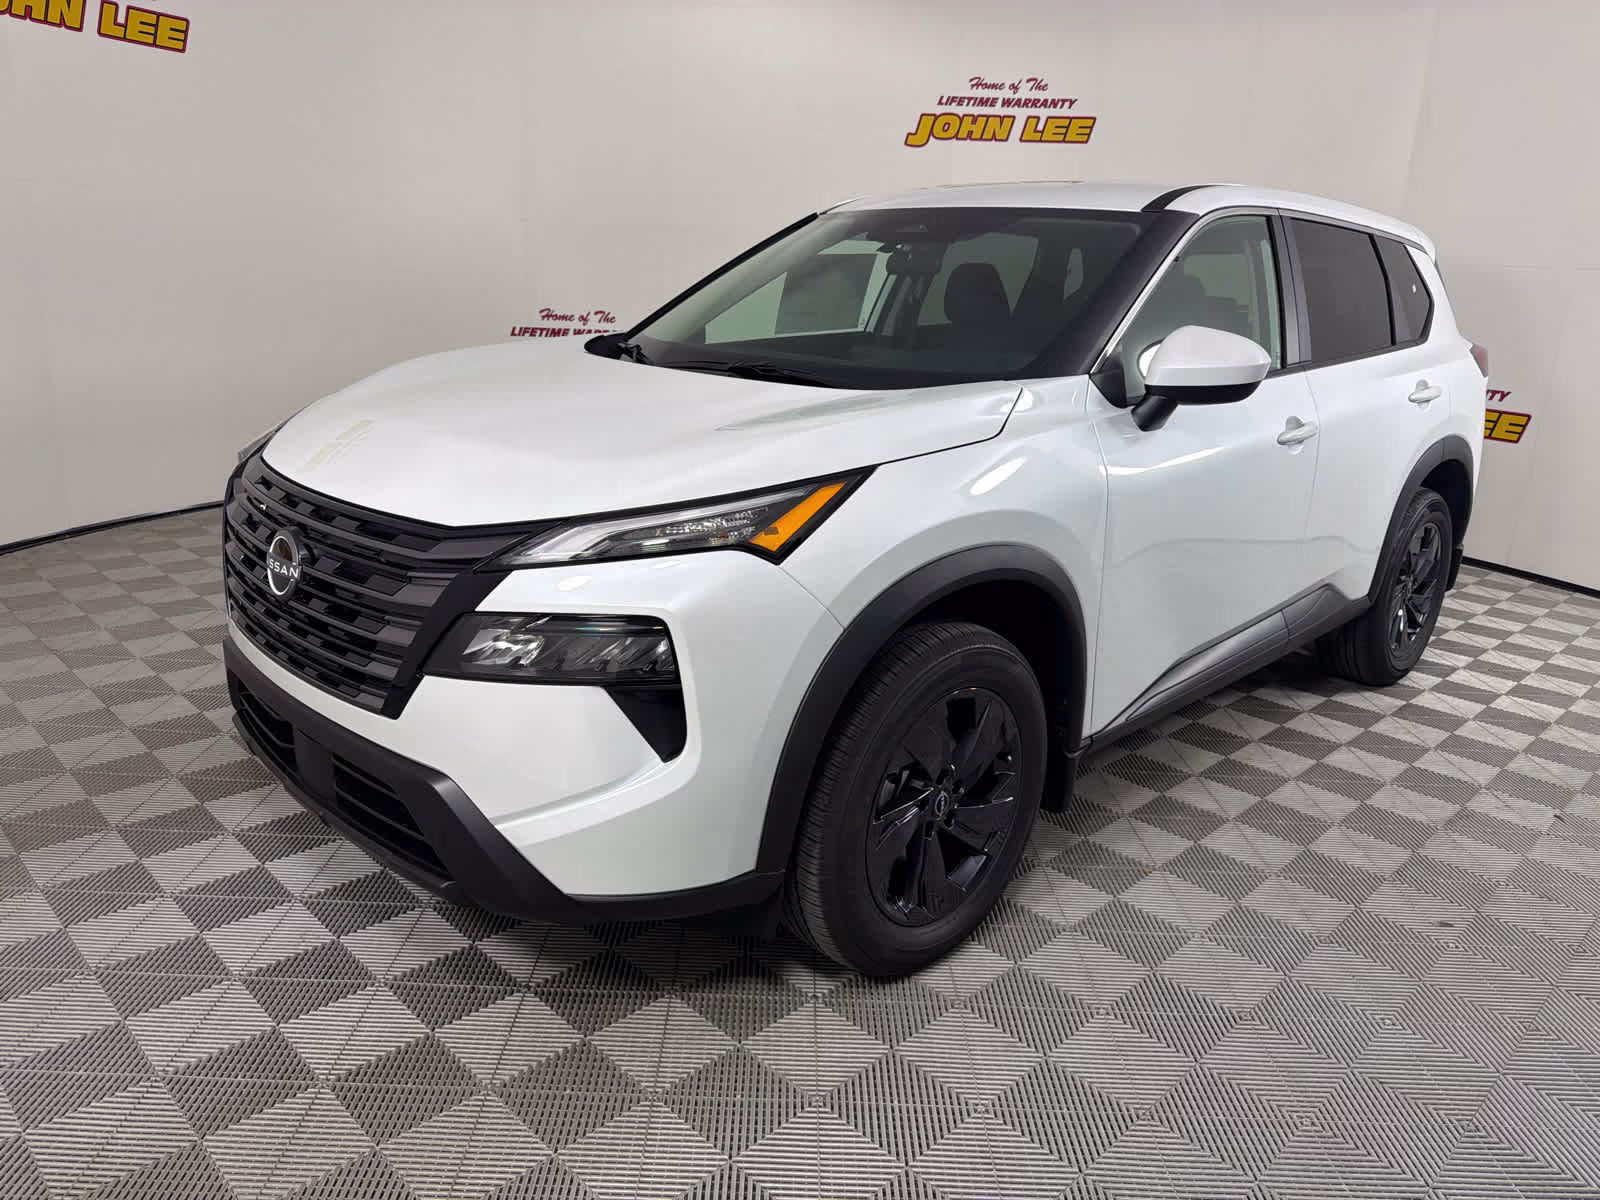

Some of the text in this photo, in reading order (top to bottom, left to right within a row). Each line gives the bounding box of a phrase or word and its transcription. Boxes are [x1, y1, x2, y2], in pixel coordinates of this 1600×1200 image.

[98, 0, 189, 53] LEE
[969, 77, 1048, 94] Home of The
[937, 96, 1078, 109] LIFETIME WARRANTY
[905, 113, 1097, 147] JOHN LEE
[539, 308, 616, 326] Home of The
[510, 326, 570, 338] LIFETIME
[267, 556, 298, 578] SSAN
